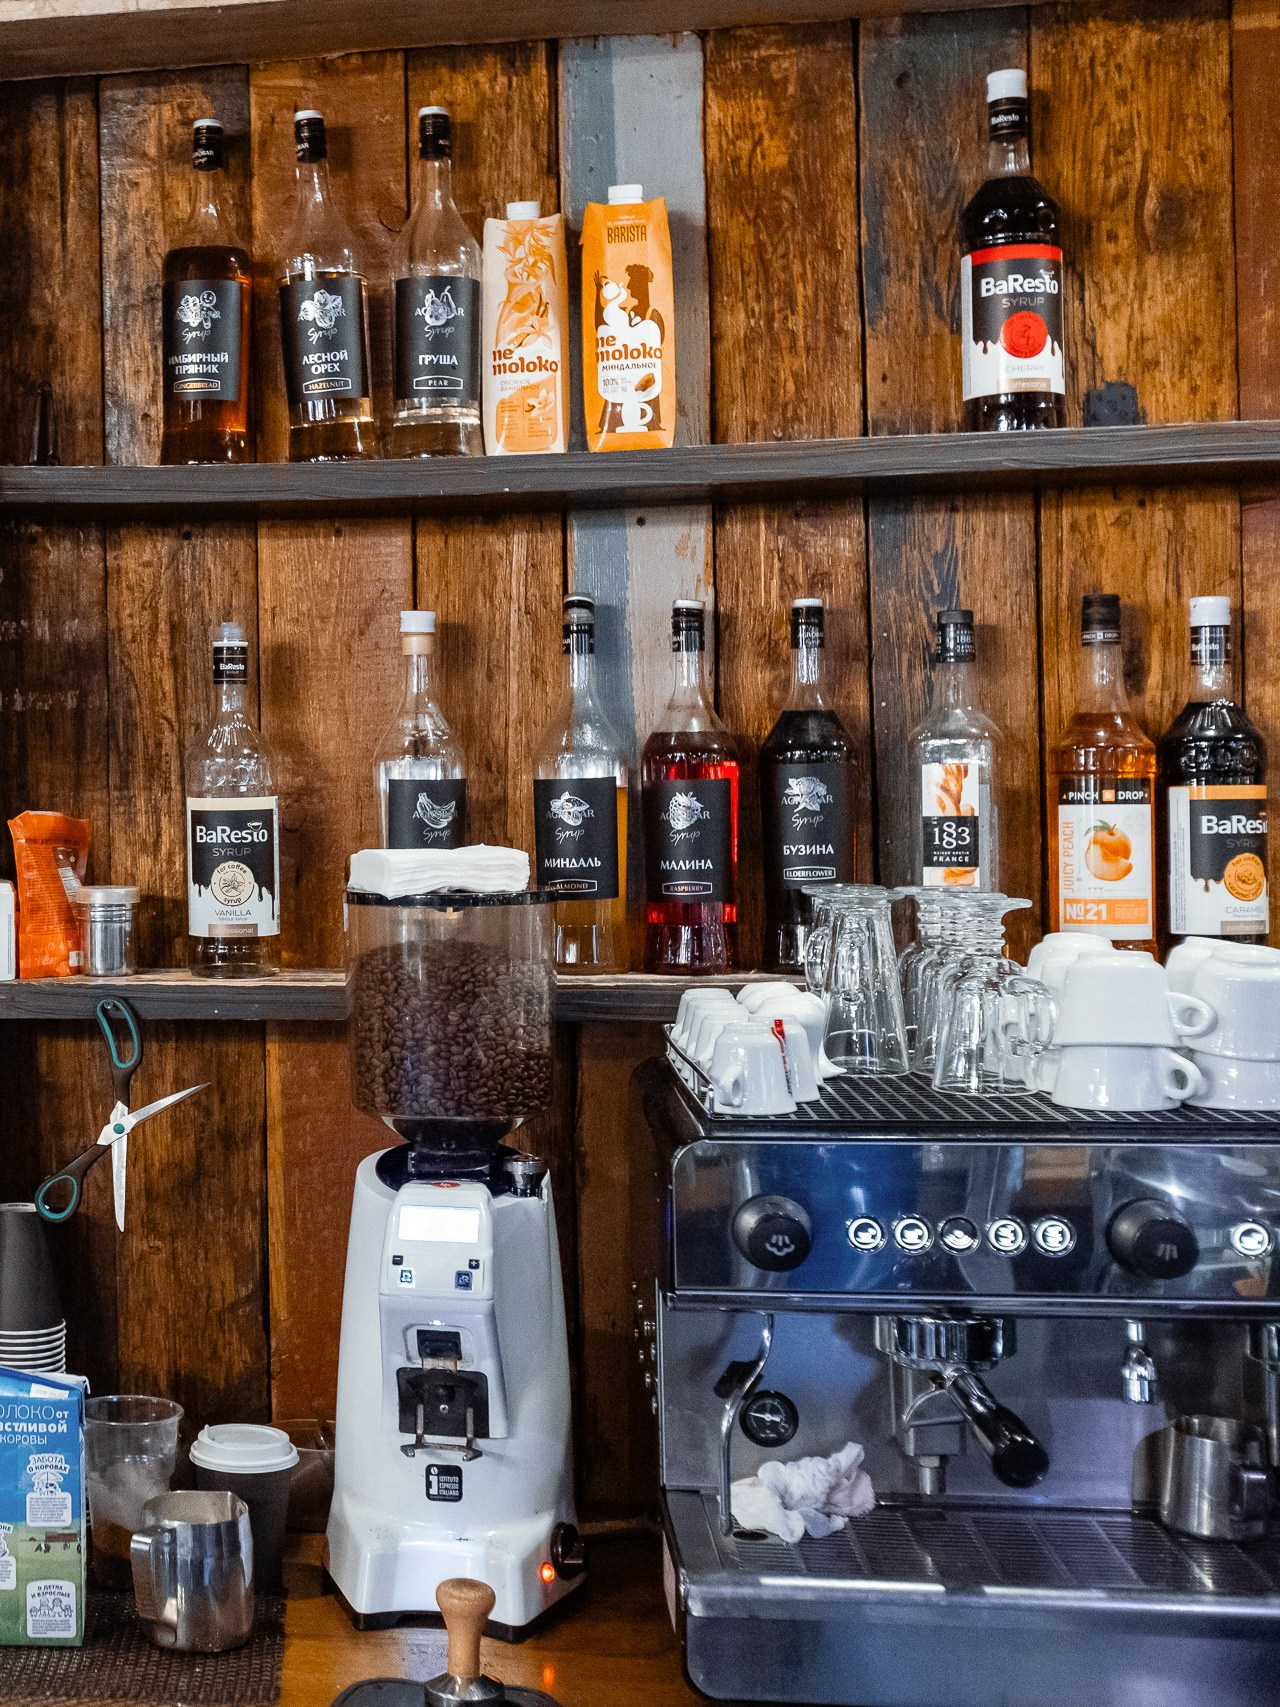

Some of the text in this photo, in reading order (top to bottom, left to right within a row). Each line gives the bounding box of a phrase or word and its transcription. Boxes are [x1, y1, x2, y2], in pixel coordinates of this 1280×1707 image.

[607, 224, 647, 244] BARISTA
[980, 270, 1059, 298] BaResto
[1001, 297, 1045, 308] SYRUP
[182, 328, 211, 345] Syrup
[307, 327, 338, 345] Syrup
[424, 324, 455, 341] Syrup
[595, 335, 616, 350] ne
[168, 352, 229, 365] ИМБИРНЫЙ
[302, 349, 349, 365] ЛЕСНОЙ
[492, 348, 514, 362] ne
[595, 342, 663, 364] moloko
[418, 354, 459, 366] ГРУША
[492, 355, 559, 376] moloko
[175, 364, 220, 375] ПРЯНИК
[311, 363, 341, 375] ОРЕХ
[601, 362, 657, 372] МИНДАЛЬНОЕ
[1005, 364, 1045, 374] CHERRY
[308, 381, 345, 390] HAZELNUT
[1068, 791, 1099, 800] PINCH
[1117, 791, 1144, 800] DROP
[792, 813, 824, 831] Syrup
[196, 822, 268, 844] BaResto
[422, 827, 451, 843] Syrup
[555, 827, 585, 844] Syrup
[669, 829, 701, 846] Syrup
[212, 847, 252, 857] SYRUP
[783, 843, 834, 856] БУЗИНА
[544, 856, 601, 869] МИНДАЛЬ
[1063, 821, 1074, 894] JUICY PEACH
[217, 863, 247, 874] for coffee
[660, 859, 713, 871] МАЛИНА
[786, 869, 833, 877] ELDERFLOWER
[556, 882, 589, 890] ALMOND
[670, 884, 703, 892] RASPBERRY
[223, 897, 242, 905] syrup
[214, 909, 252, 917] VANILLA
[1225, 906, 1265, 914] CARAMEL
[55, 1411, 69, 1419] от
[0, 1434, 47, 1445] КОРОВЫ
[31, 1455, 64, 1465] ЗАБОТА
[34, 1464, 68, 1473] КОРОВАХ
[37, 1591, 71, 1599] ВЗРОСЛЫХ
